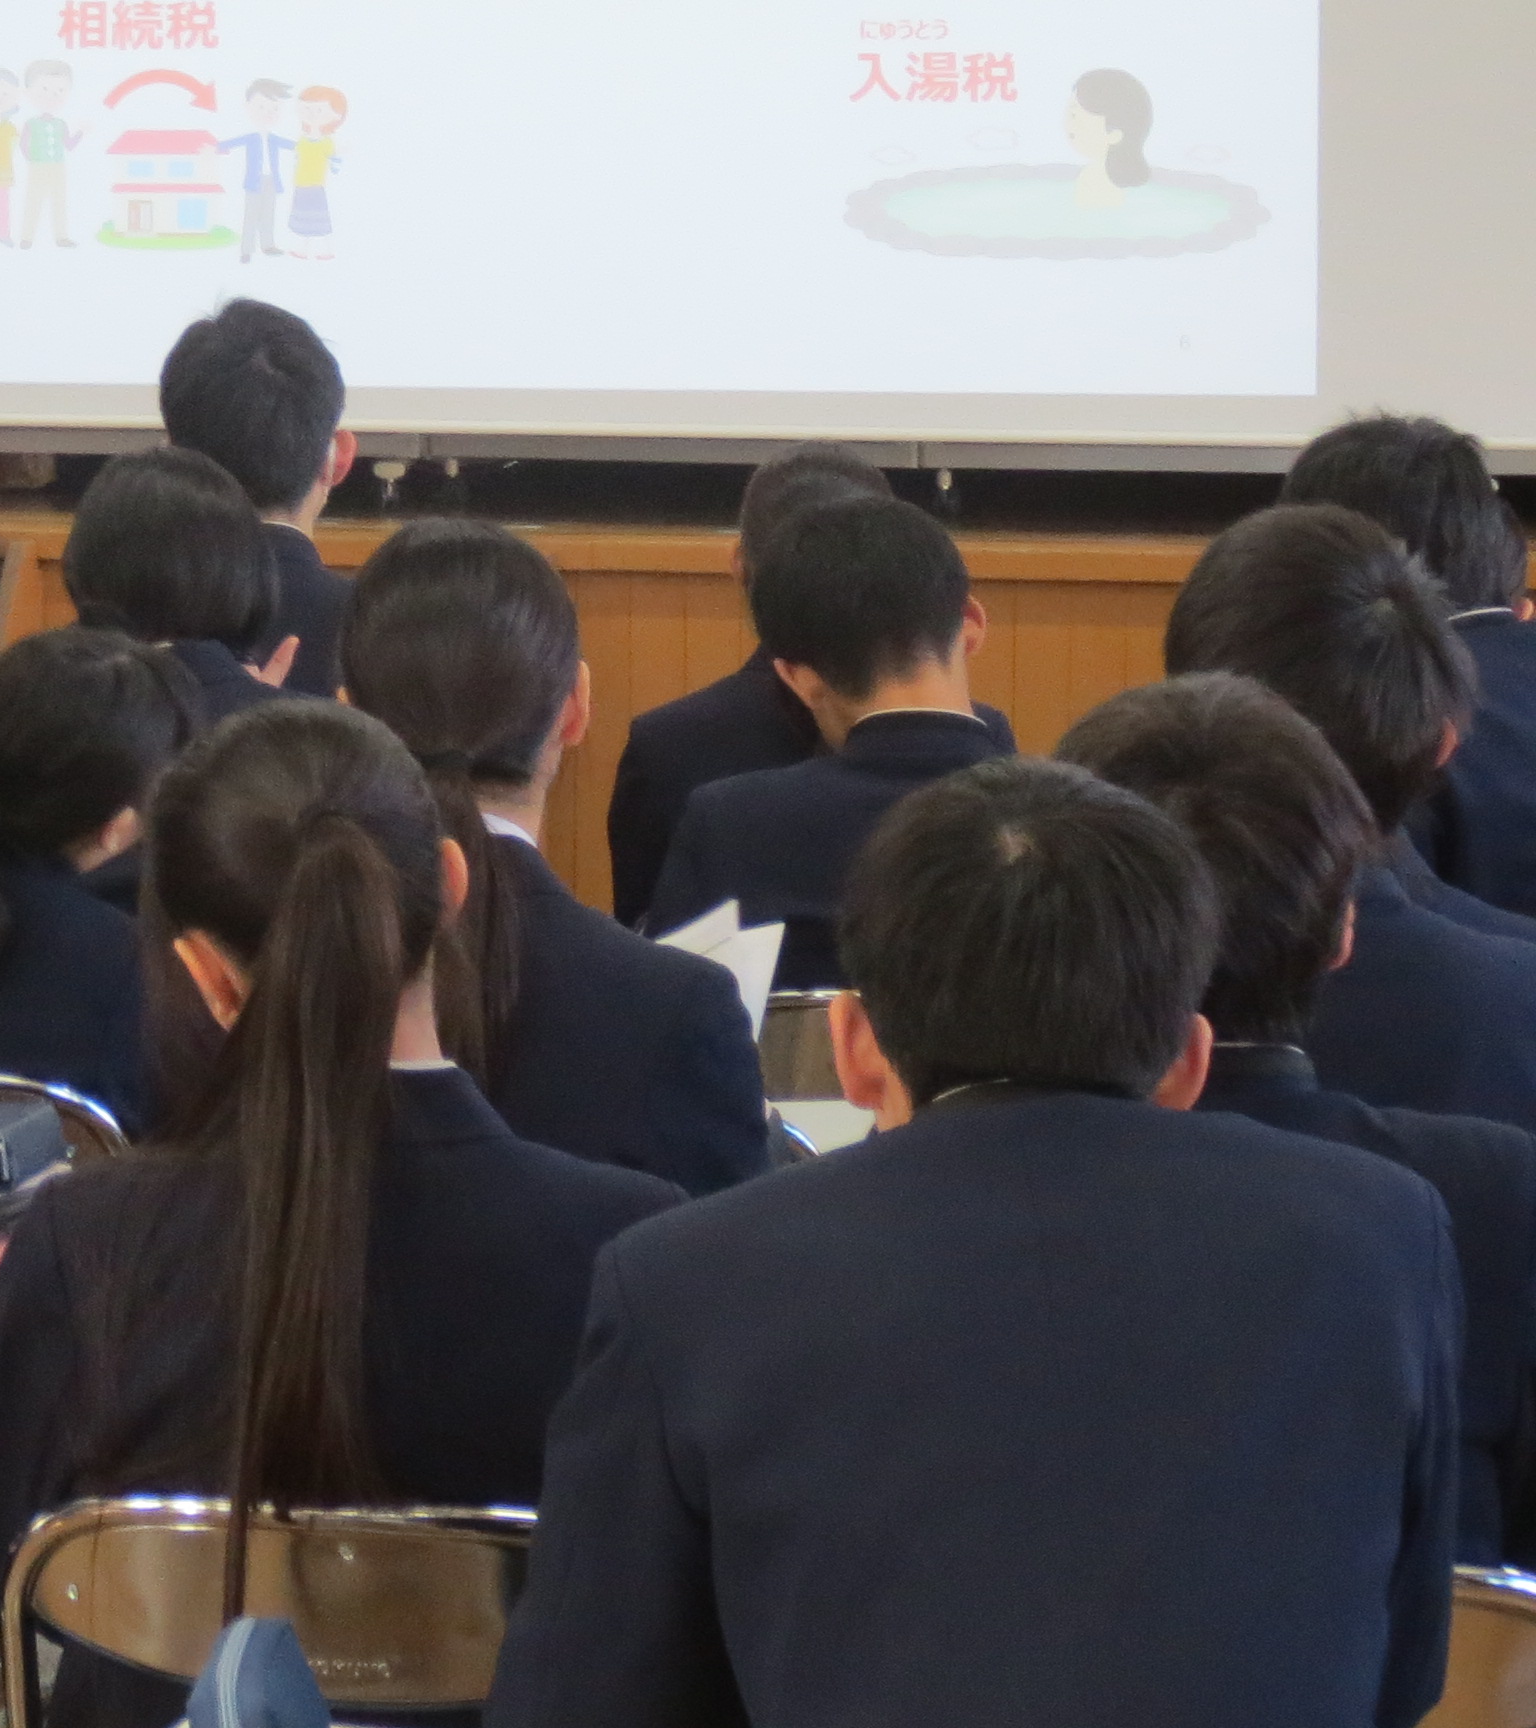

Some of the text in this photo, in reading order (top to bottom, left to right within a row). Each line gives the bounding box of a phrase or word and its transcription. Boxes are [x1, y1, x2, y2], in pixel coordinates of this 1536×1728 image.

[58, 0, 219, 50] 相続税
[859, 19, 949, 41] にゅうとう
[849, 52, 1018, 103] 入湯税
